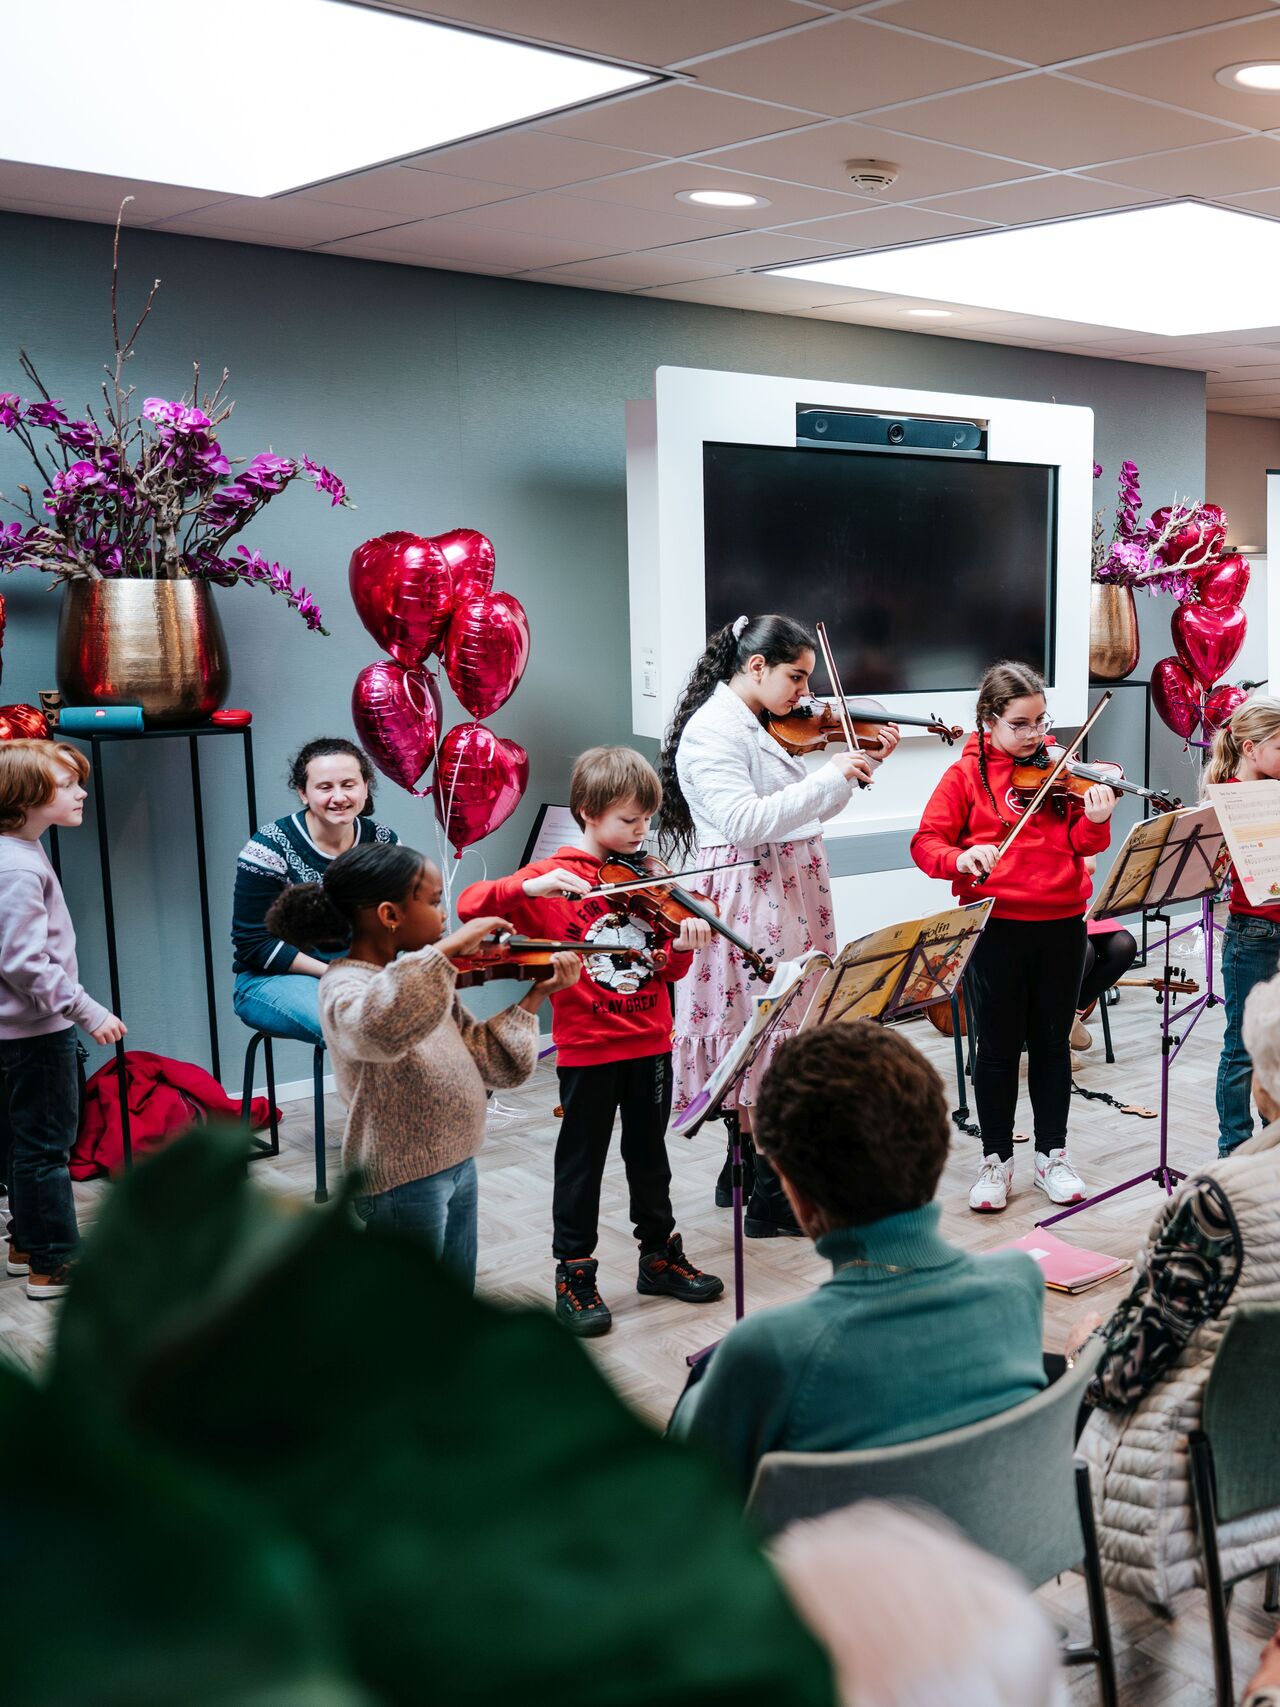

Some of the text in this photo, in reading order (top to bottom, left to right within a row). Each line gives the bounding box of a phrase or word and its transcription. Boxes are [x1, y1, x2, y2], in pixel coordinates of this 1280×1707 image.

[577, 900, 603, 923] FOR
[592, 993, 658, 1014] PLAY GREAT
